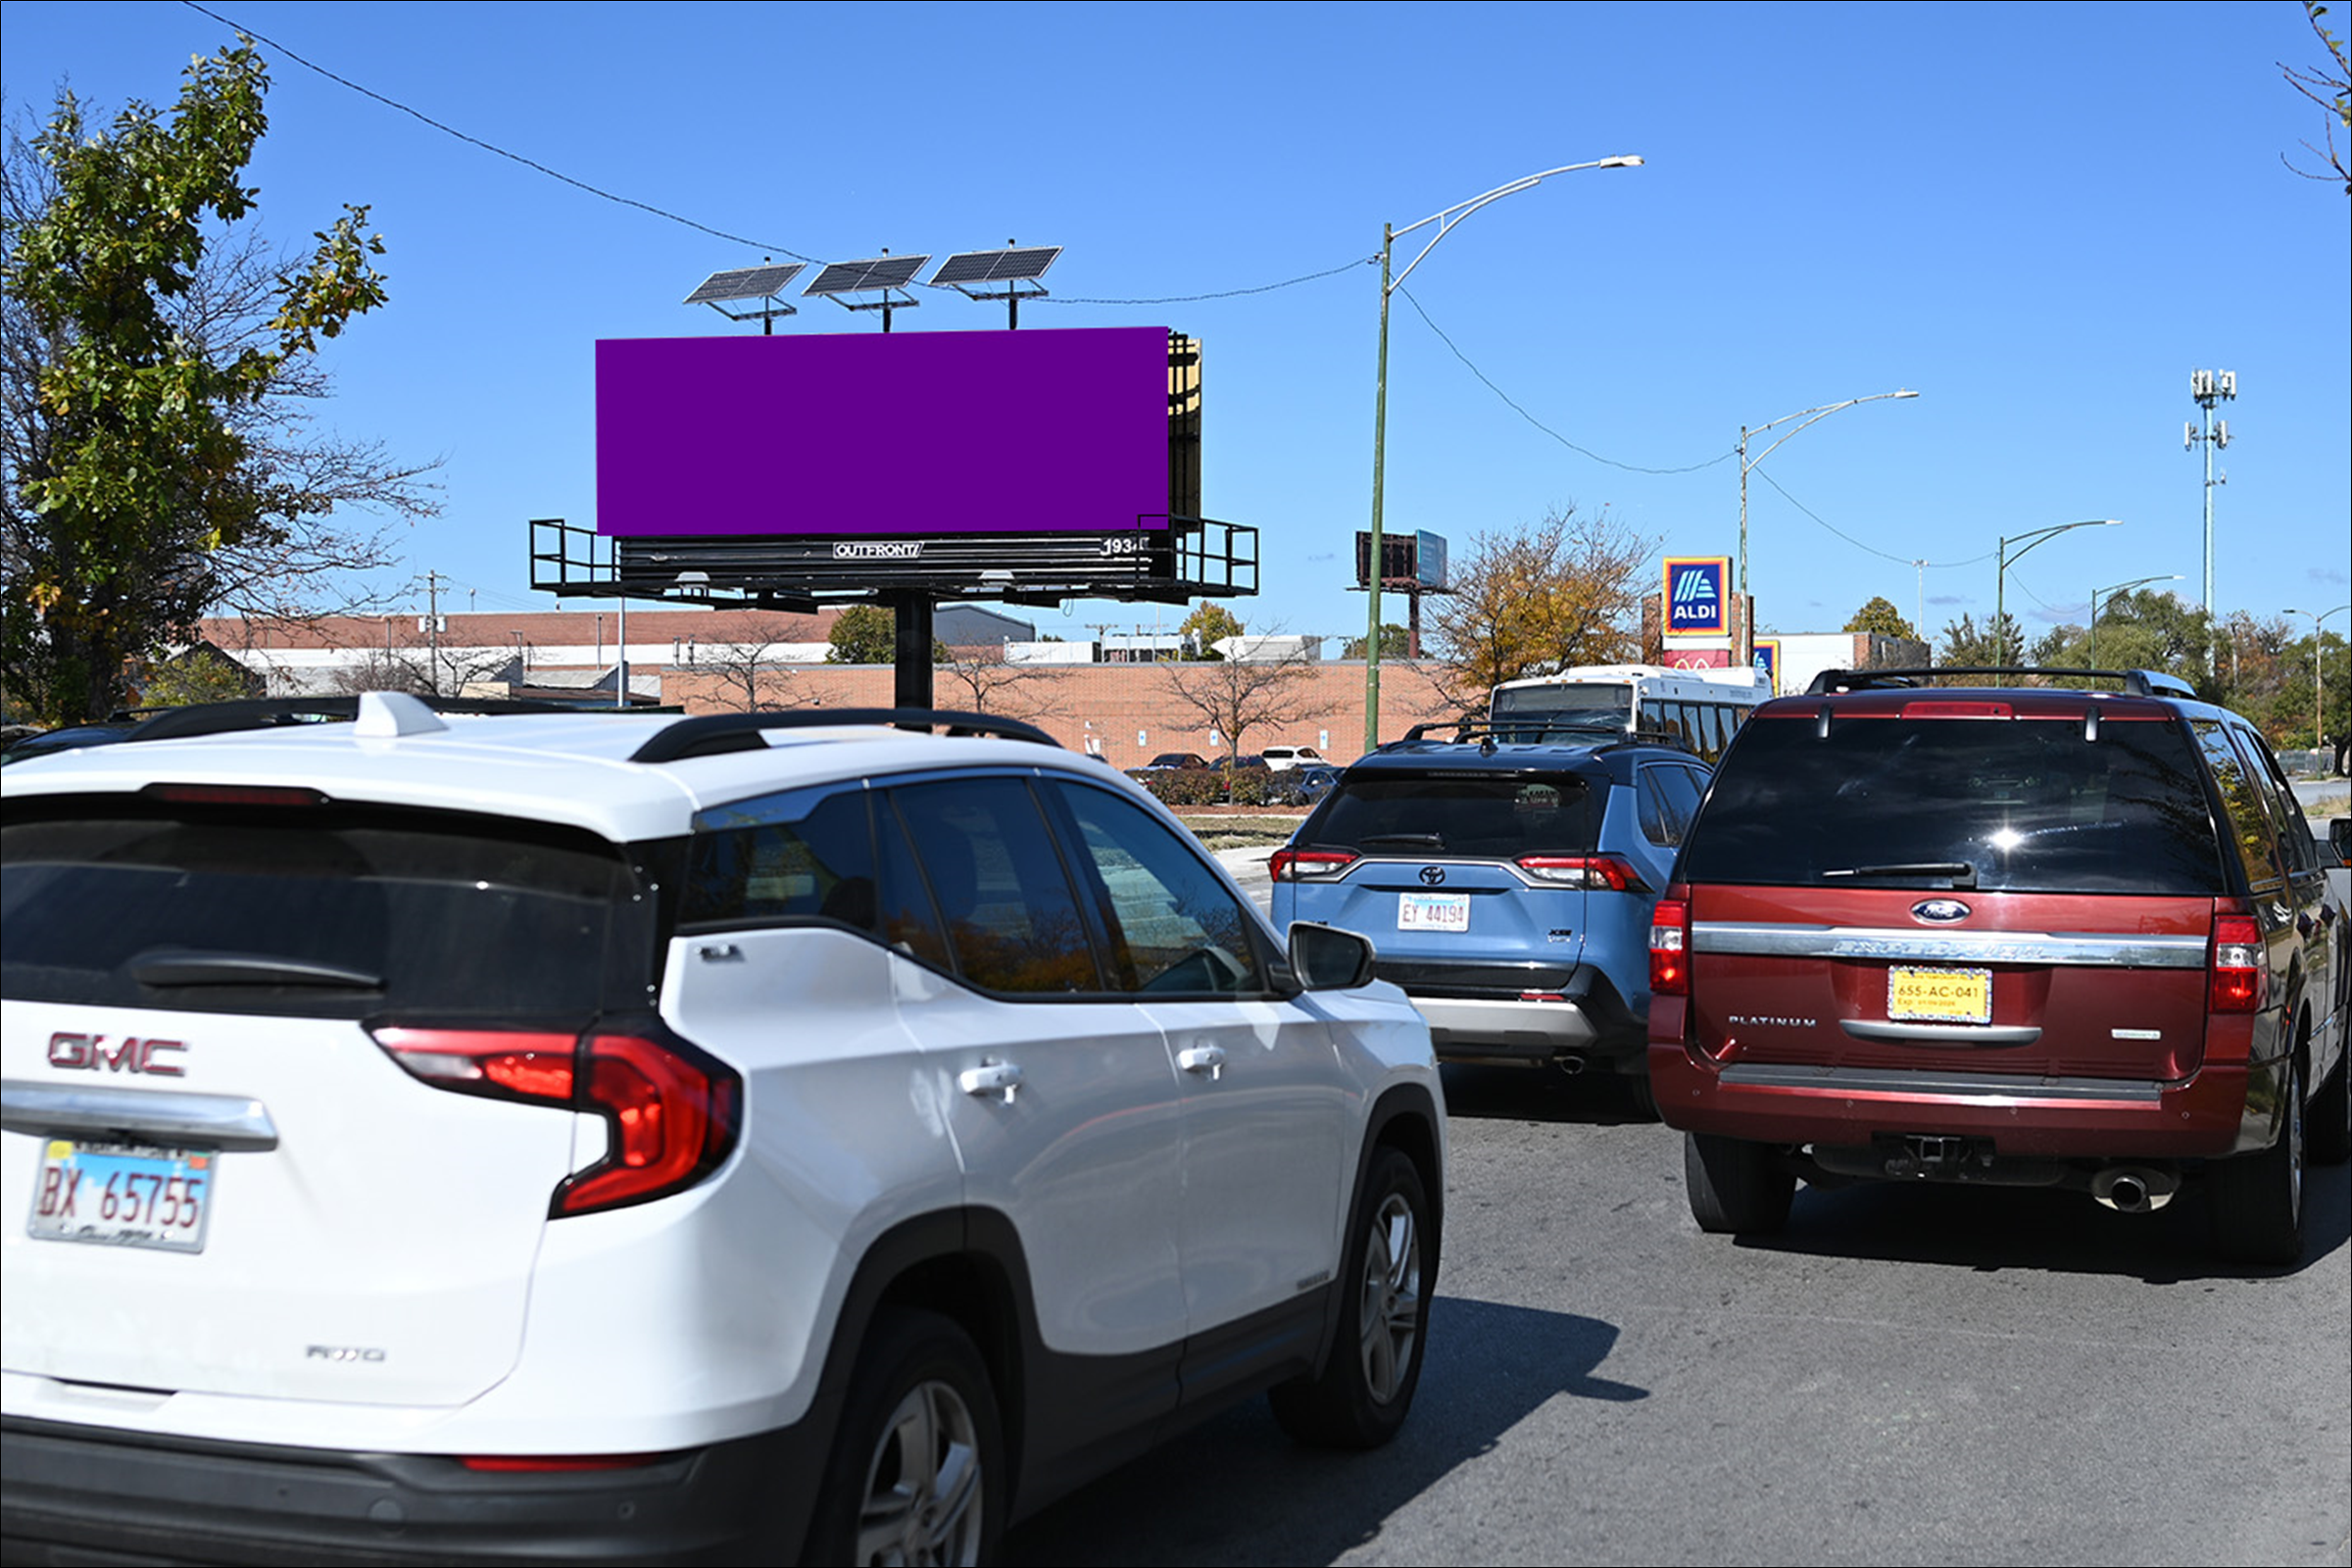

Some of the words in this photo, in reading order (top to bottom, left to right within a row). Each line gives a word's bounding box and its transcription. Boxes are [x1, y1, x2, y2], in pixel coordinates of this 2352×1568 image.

[1673, 605, 1717, 619] ALDI
[1402, 904, 1419, 923] EY
[1426, 905, 1465, 923] 44194
[1897, 985, 1979, 998] 655-AC-041
[1728, 1015, 1817, 1027] PLATINUM
[49, 1032, 188, 1077] GMC
[37, 1166, 83, 1218] BX
[100, 1171, 204, 1229] 65755
